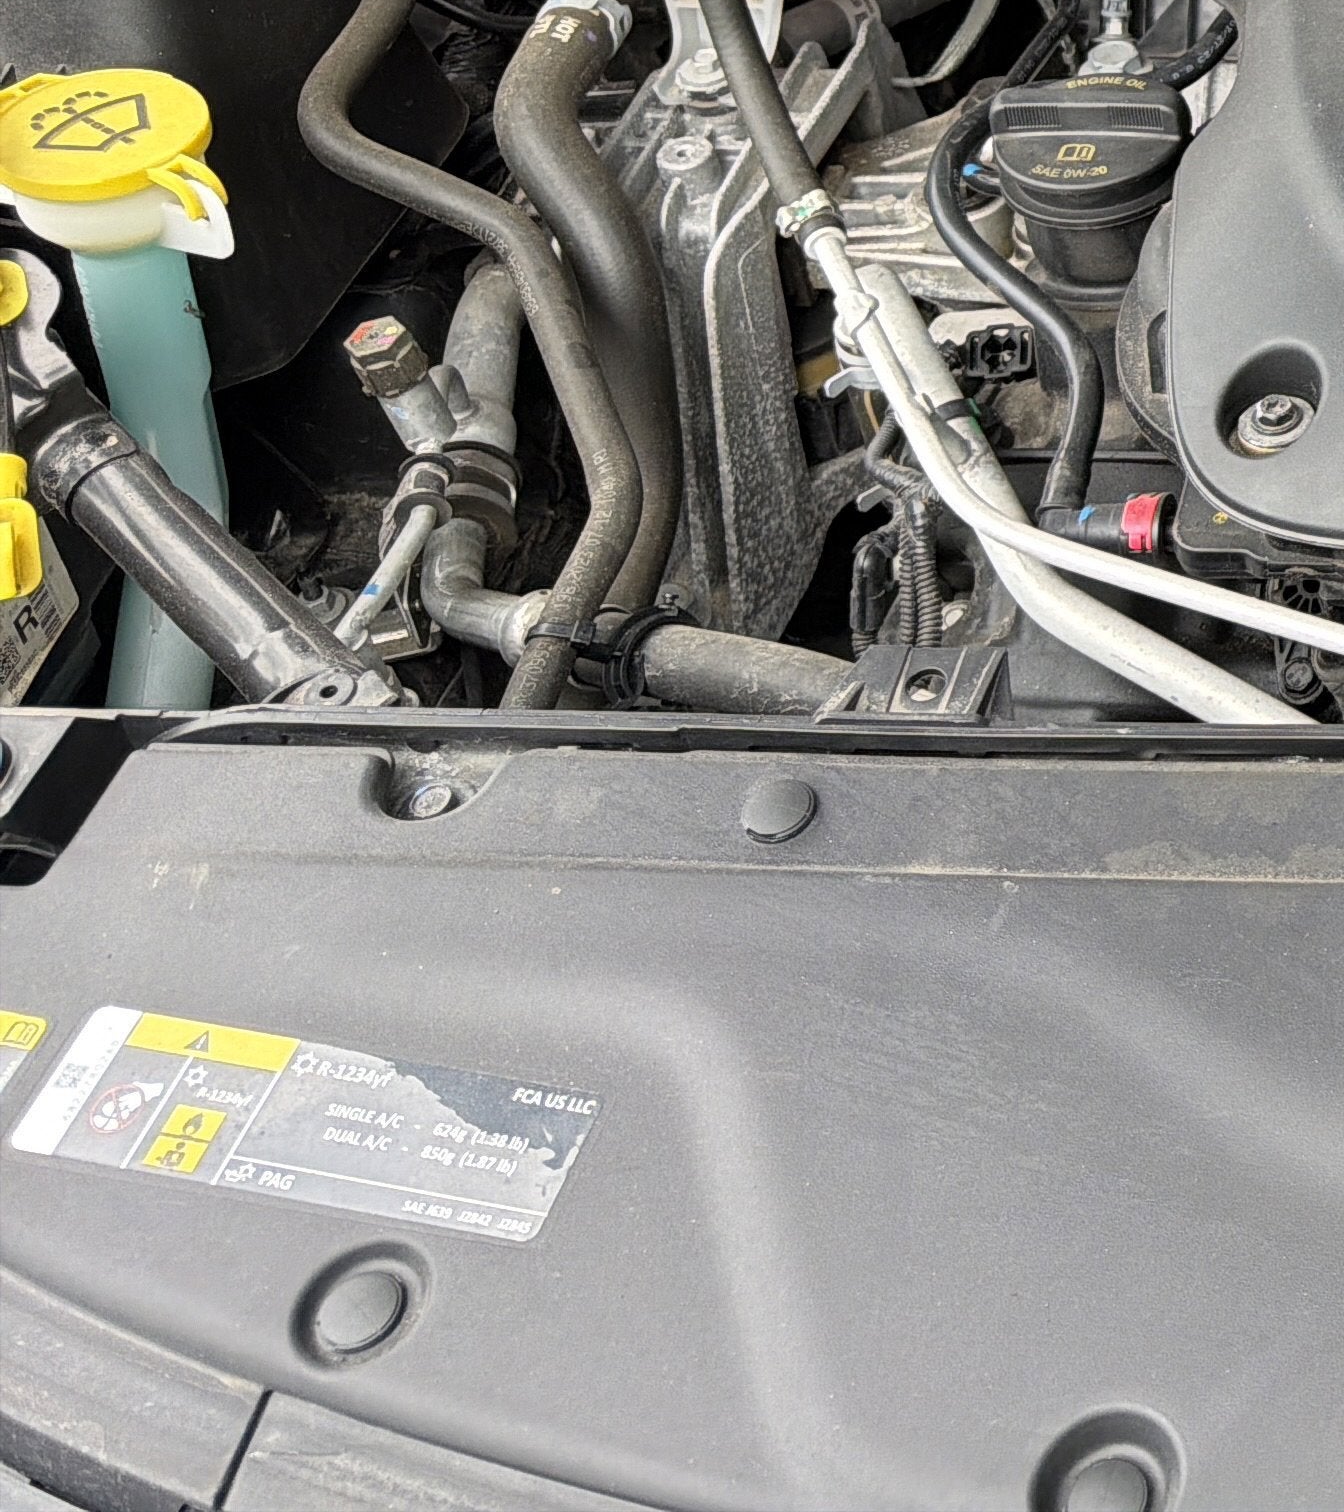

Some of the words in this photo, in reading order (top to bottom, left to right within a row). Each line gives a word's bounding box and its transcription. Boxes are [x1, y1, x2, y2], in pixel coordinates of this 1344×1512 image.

[1066, 76, 1124, 89] ENGINE
[1126, 78, 1148, 90] OIL
[1031, 164, 1062, 177] SAE
[1063, 165, 1108, 179] 0W-20
[13, 604, 39, 646] R
[317, 1061, 392, 1088] R-1234yf
[196, 1087, 253, 1108] R-1234yf
[513, 1088, 542, 1106] FCA
[545, 1093, 565, 1110] US
[567, 1098, 597, 1115] LLC
[325, 1103, 372, 1123] SINGLE
[374, 1112, 404, 1129] A/C
[433, 1123, 468, 1143] 624g
[323, 1127, 360, 1145] DUAL
[362, 1135, 392, 1151] A/C
[421, 1145, 456, 1166] 850g
[459, 1151, 496, 1170] (1.87
[258, 1170, 296, 1190] PAG
[402, 1199, 426, 1215] SAE
